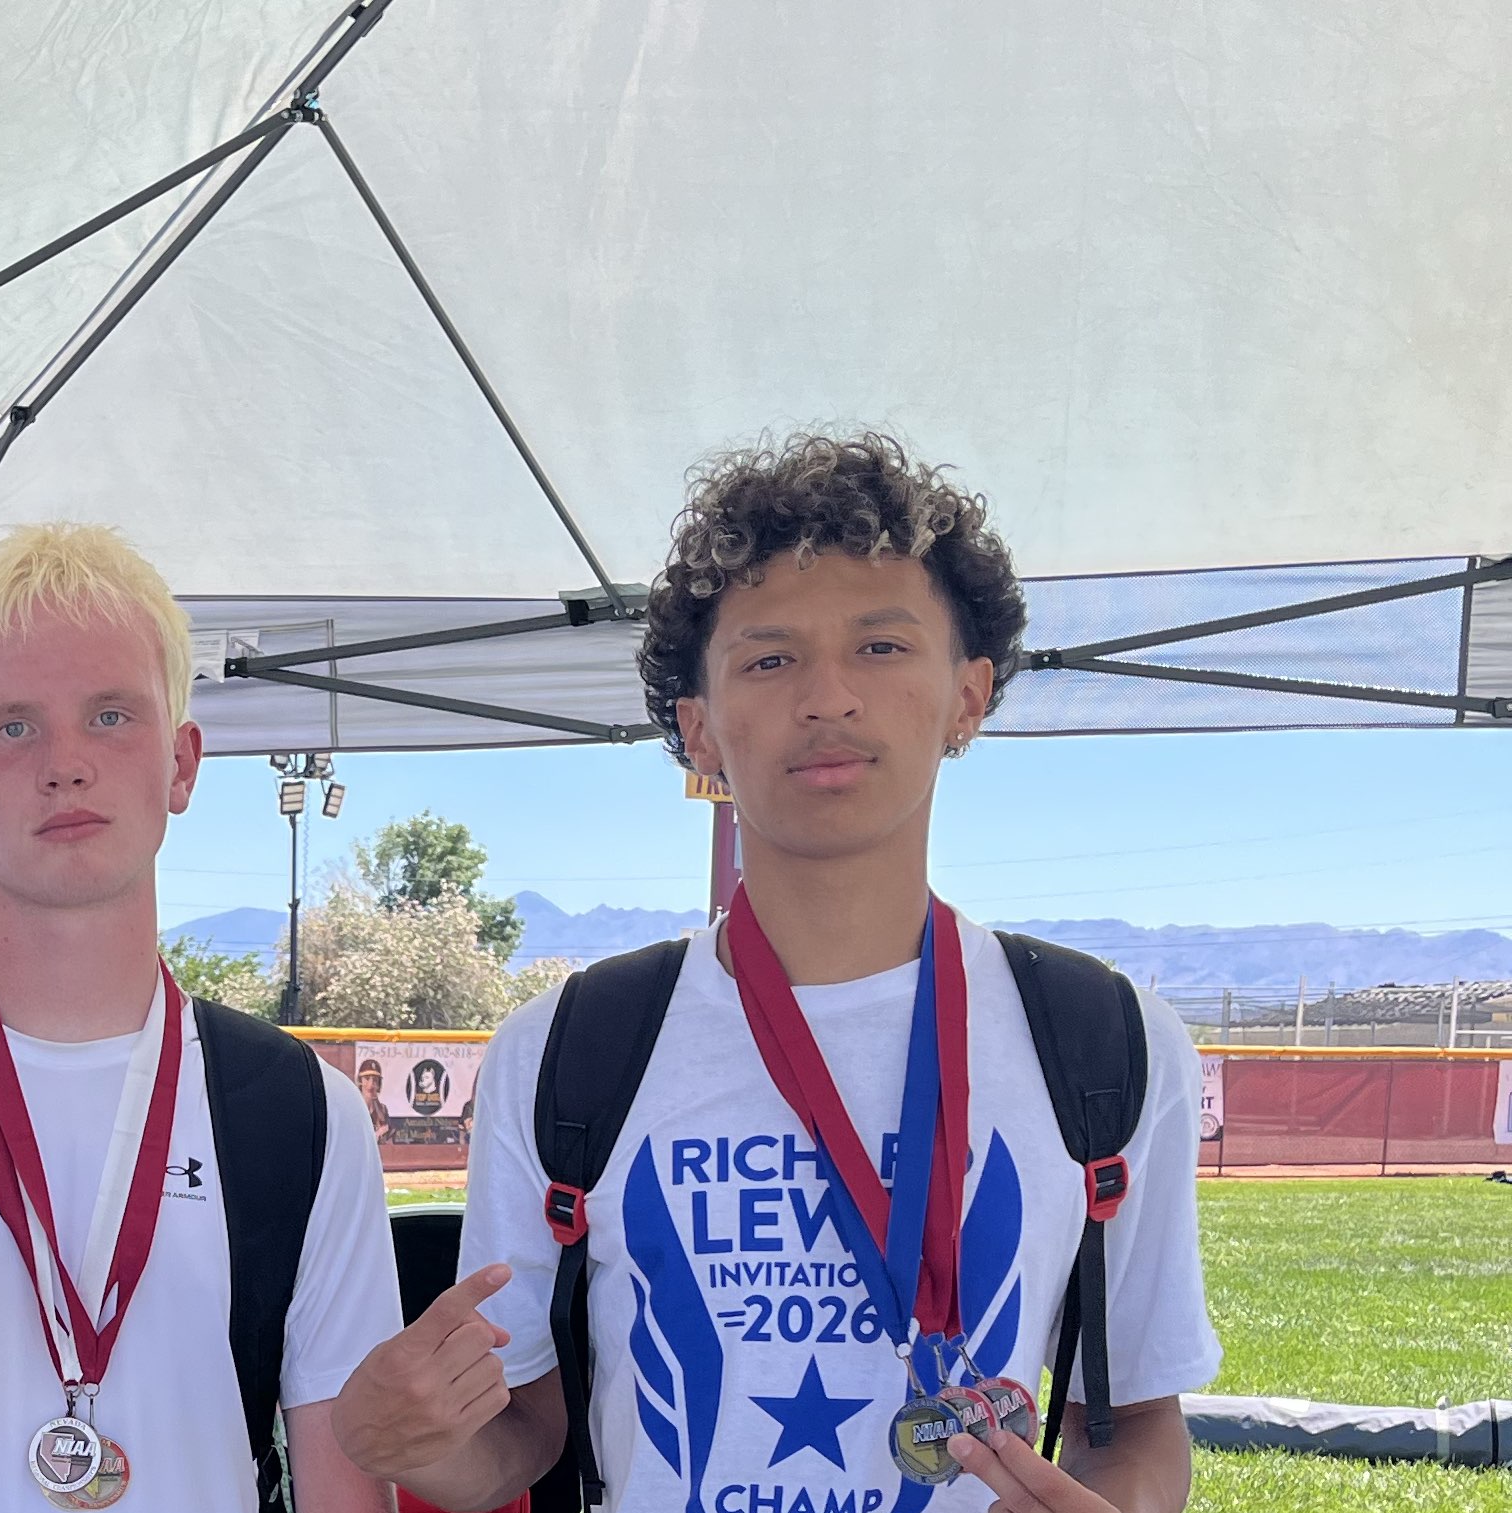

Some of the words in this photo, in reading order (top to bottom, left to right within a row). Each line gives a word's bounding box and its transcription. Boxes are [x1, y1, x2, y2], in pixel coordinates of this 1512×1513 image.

[672, 1133, 974, 1185] RICH
[692, 1187, 893, 1254] LEW
[709, 1262, 864, 1288] INVITATIO
[741, 1294, 884, 1344] 2026
[961, 1401, 989, 1427] AA
[912, 1419, 959, 1444] NIAA
[51, 1438, 97, 1456] NIAA
[99, 1456, 126, 1473] AA
